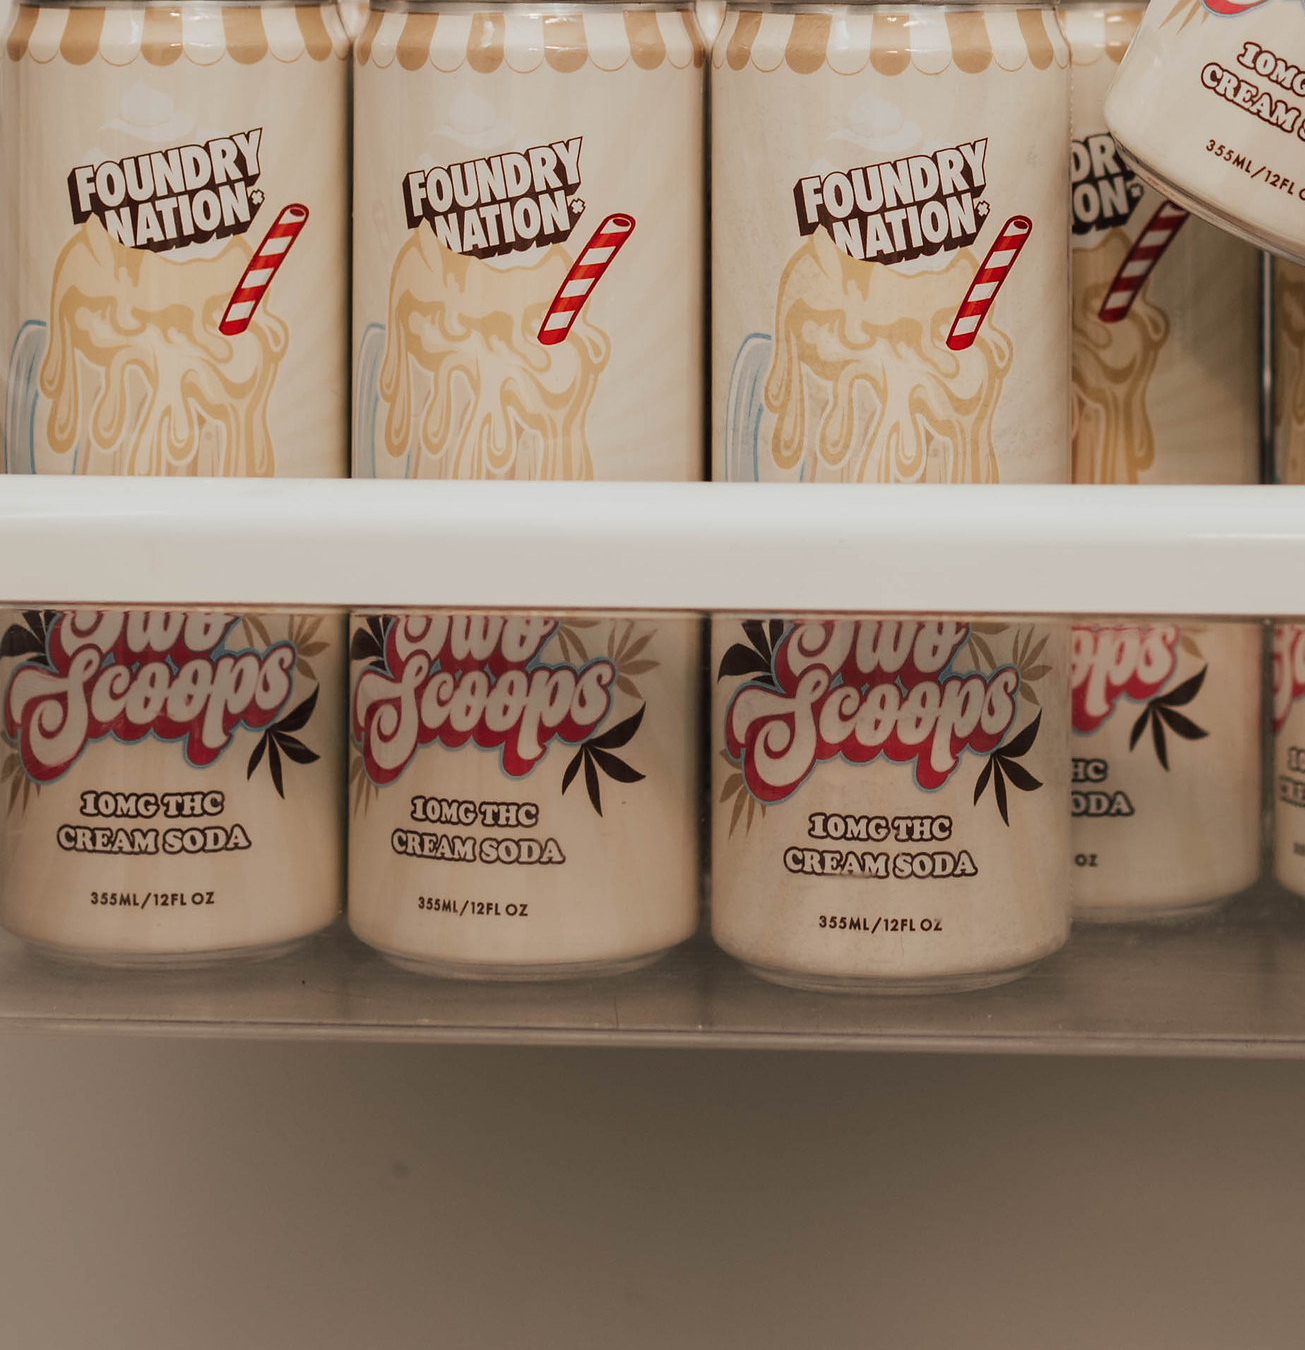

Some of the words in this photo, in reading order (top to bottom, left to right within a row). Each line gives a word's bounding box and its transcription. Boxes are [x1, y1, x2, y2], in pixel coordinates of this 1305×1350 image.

[1201, 62, 1301, 133] CREAM
[68, 127, 262, 217] FOUNDRY
[402, 136, 583, 223] FOUNDRY
[793, 137, 988, 230] FOUNDRY
[1206, 139, 1294, 195] 355ML/12FL
[103, 180, 252, 250] NATION
[433, 189, 573, 256] NATION
[832, 192, 979, 263] NATION
[1071, 625, 1179, 733] ops
[6, 643, 297, 780] Scoops
[354, 650, 616, 783] Scoops
[726, 663, 1021, 801] Scoops
[1071, 758, 1108, 782] HC
[80, 790, 160, 817] 10MG
[161, 791, 224, 817] THC
[411, 796, 477, 826] 10MG
[479, 801, 539, 828] THC
[808, 813, 890, 841] 10MG
[892, 815, 952, 842] THC
[1071, 790, 1135, 817] ODA
[57, 824, 158, 854] CREAM
[162, 823, 251, 853] SODA
[391, 829, 476, 862] CREAM
[479, 838, 565, 864] SODA
[784, 847, 889, 879] CREAM
[893, 850, 978, 879] SODA
[90, 892, 187, 909] 355ML/12FL
[191, 892, 215, 906] OZ
[418, 896, 501, 916] 355ML/12FL
[505, 903, 528, 917] OZ
[819, 915, 916, 933] 355ML/12FL
[920, 919, 942, 932] OZ
